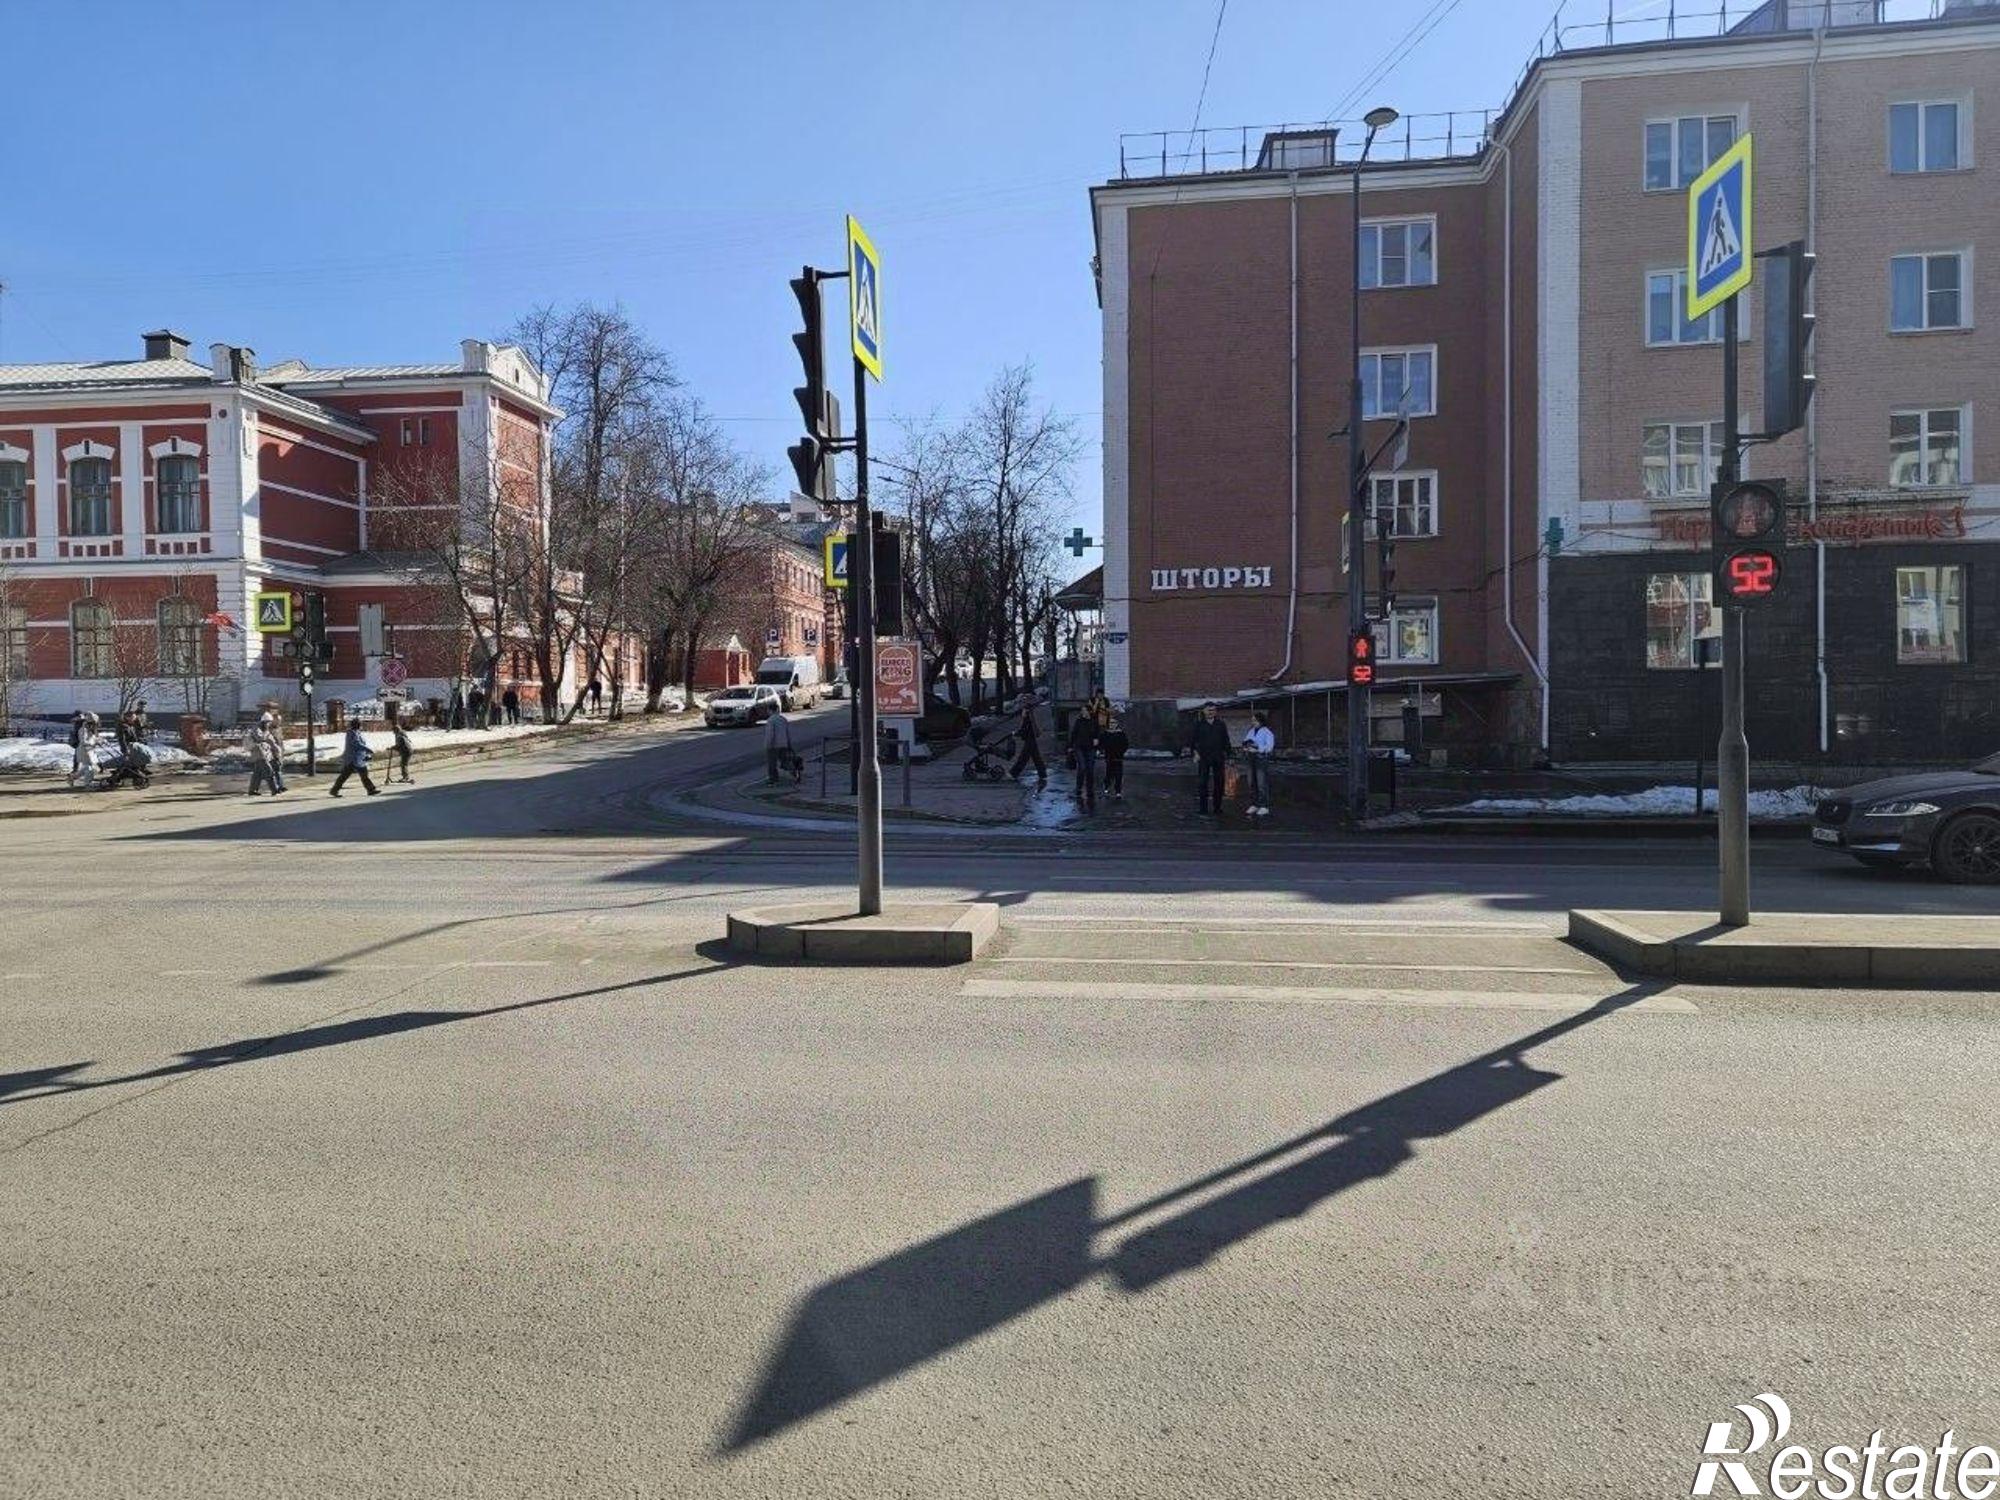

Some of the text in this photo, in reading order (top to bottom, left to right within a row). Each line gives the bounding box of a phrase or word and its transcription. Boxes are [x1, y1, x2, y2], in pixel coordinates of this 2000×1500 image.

[1151, 566, 1272, 591] ШТОРЫ
[1731, 555, 1774, 593] 52
[880, 666, 912, 677] KING
